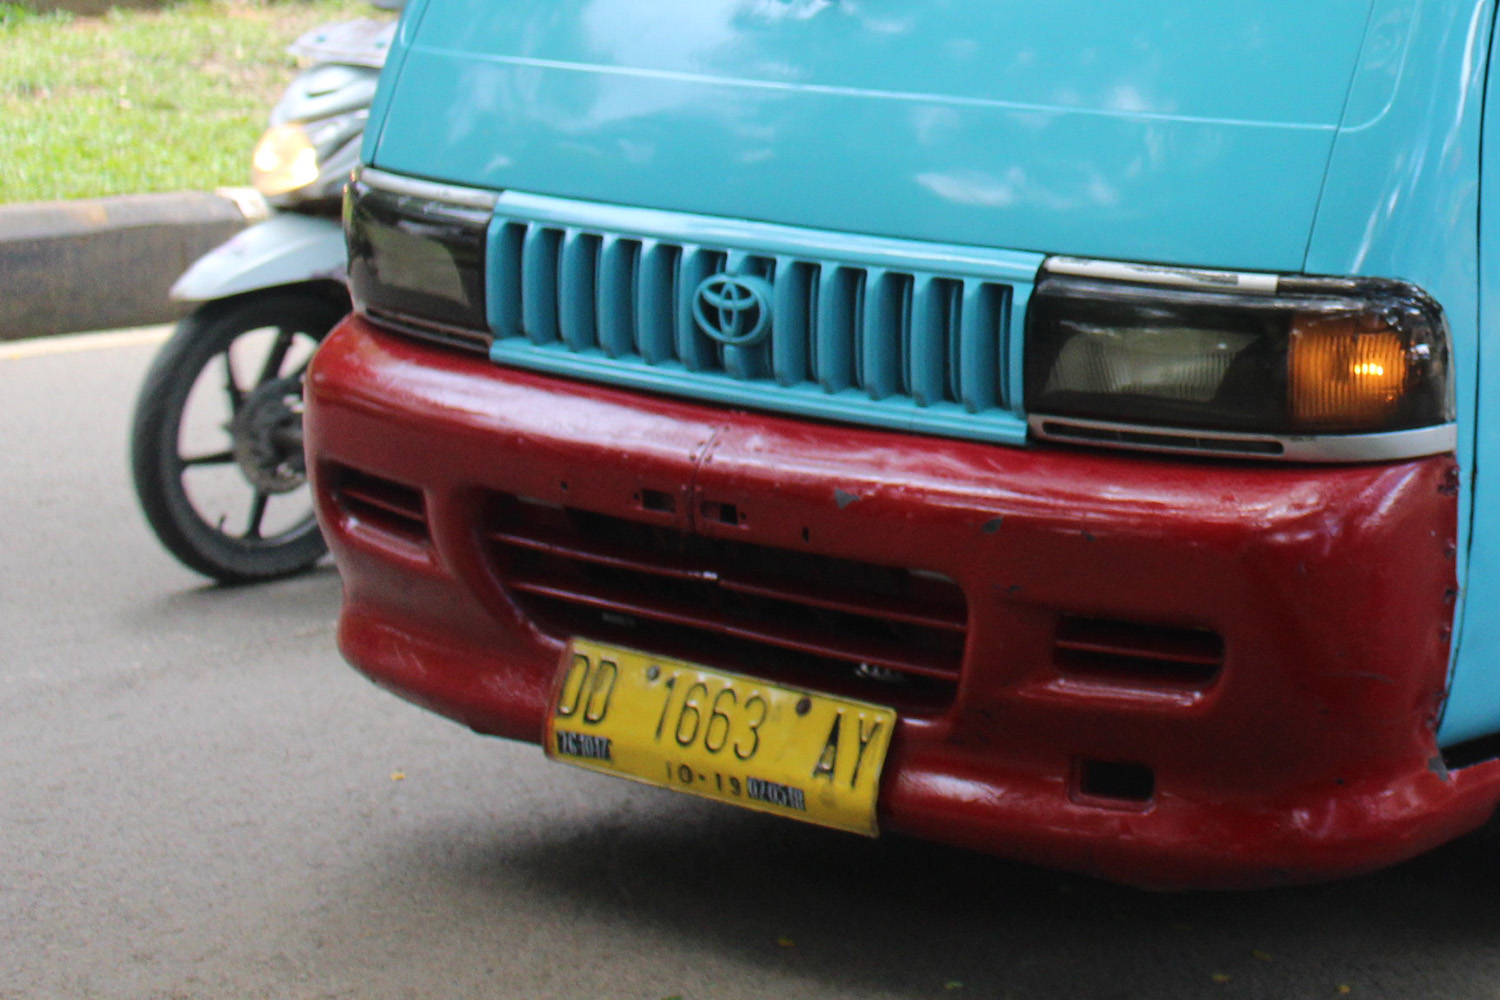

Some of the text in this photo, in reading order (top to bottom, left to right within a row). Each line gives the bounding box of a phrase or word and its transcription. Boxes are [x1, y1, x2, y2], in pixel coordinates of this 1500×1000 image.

[557, 652, 884, 788] DD 1663 AY
